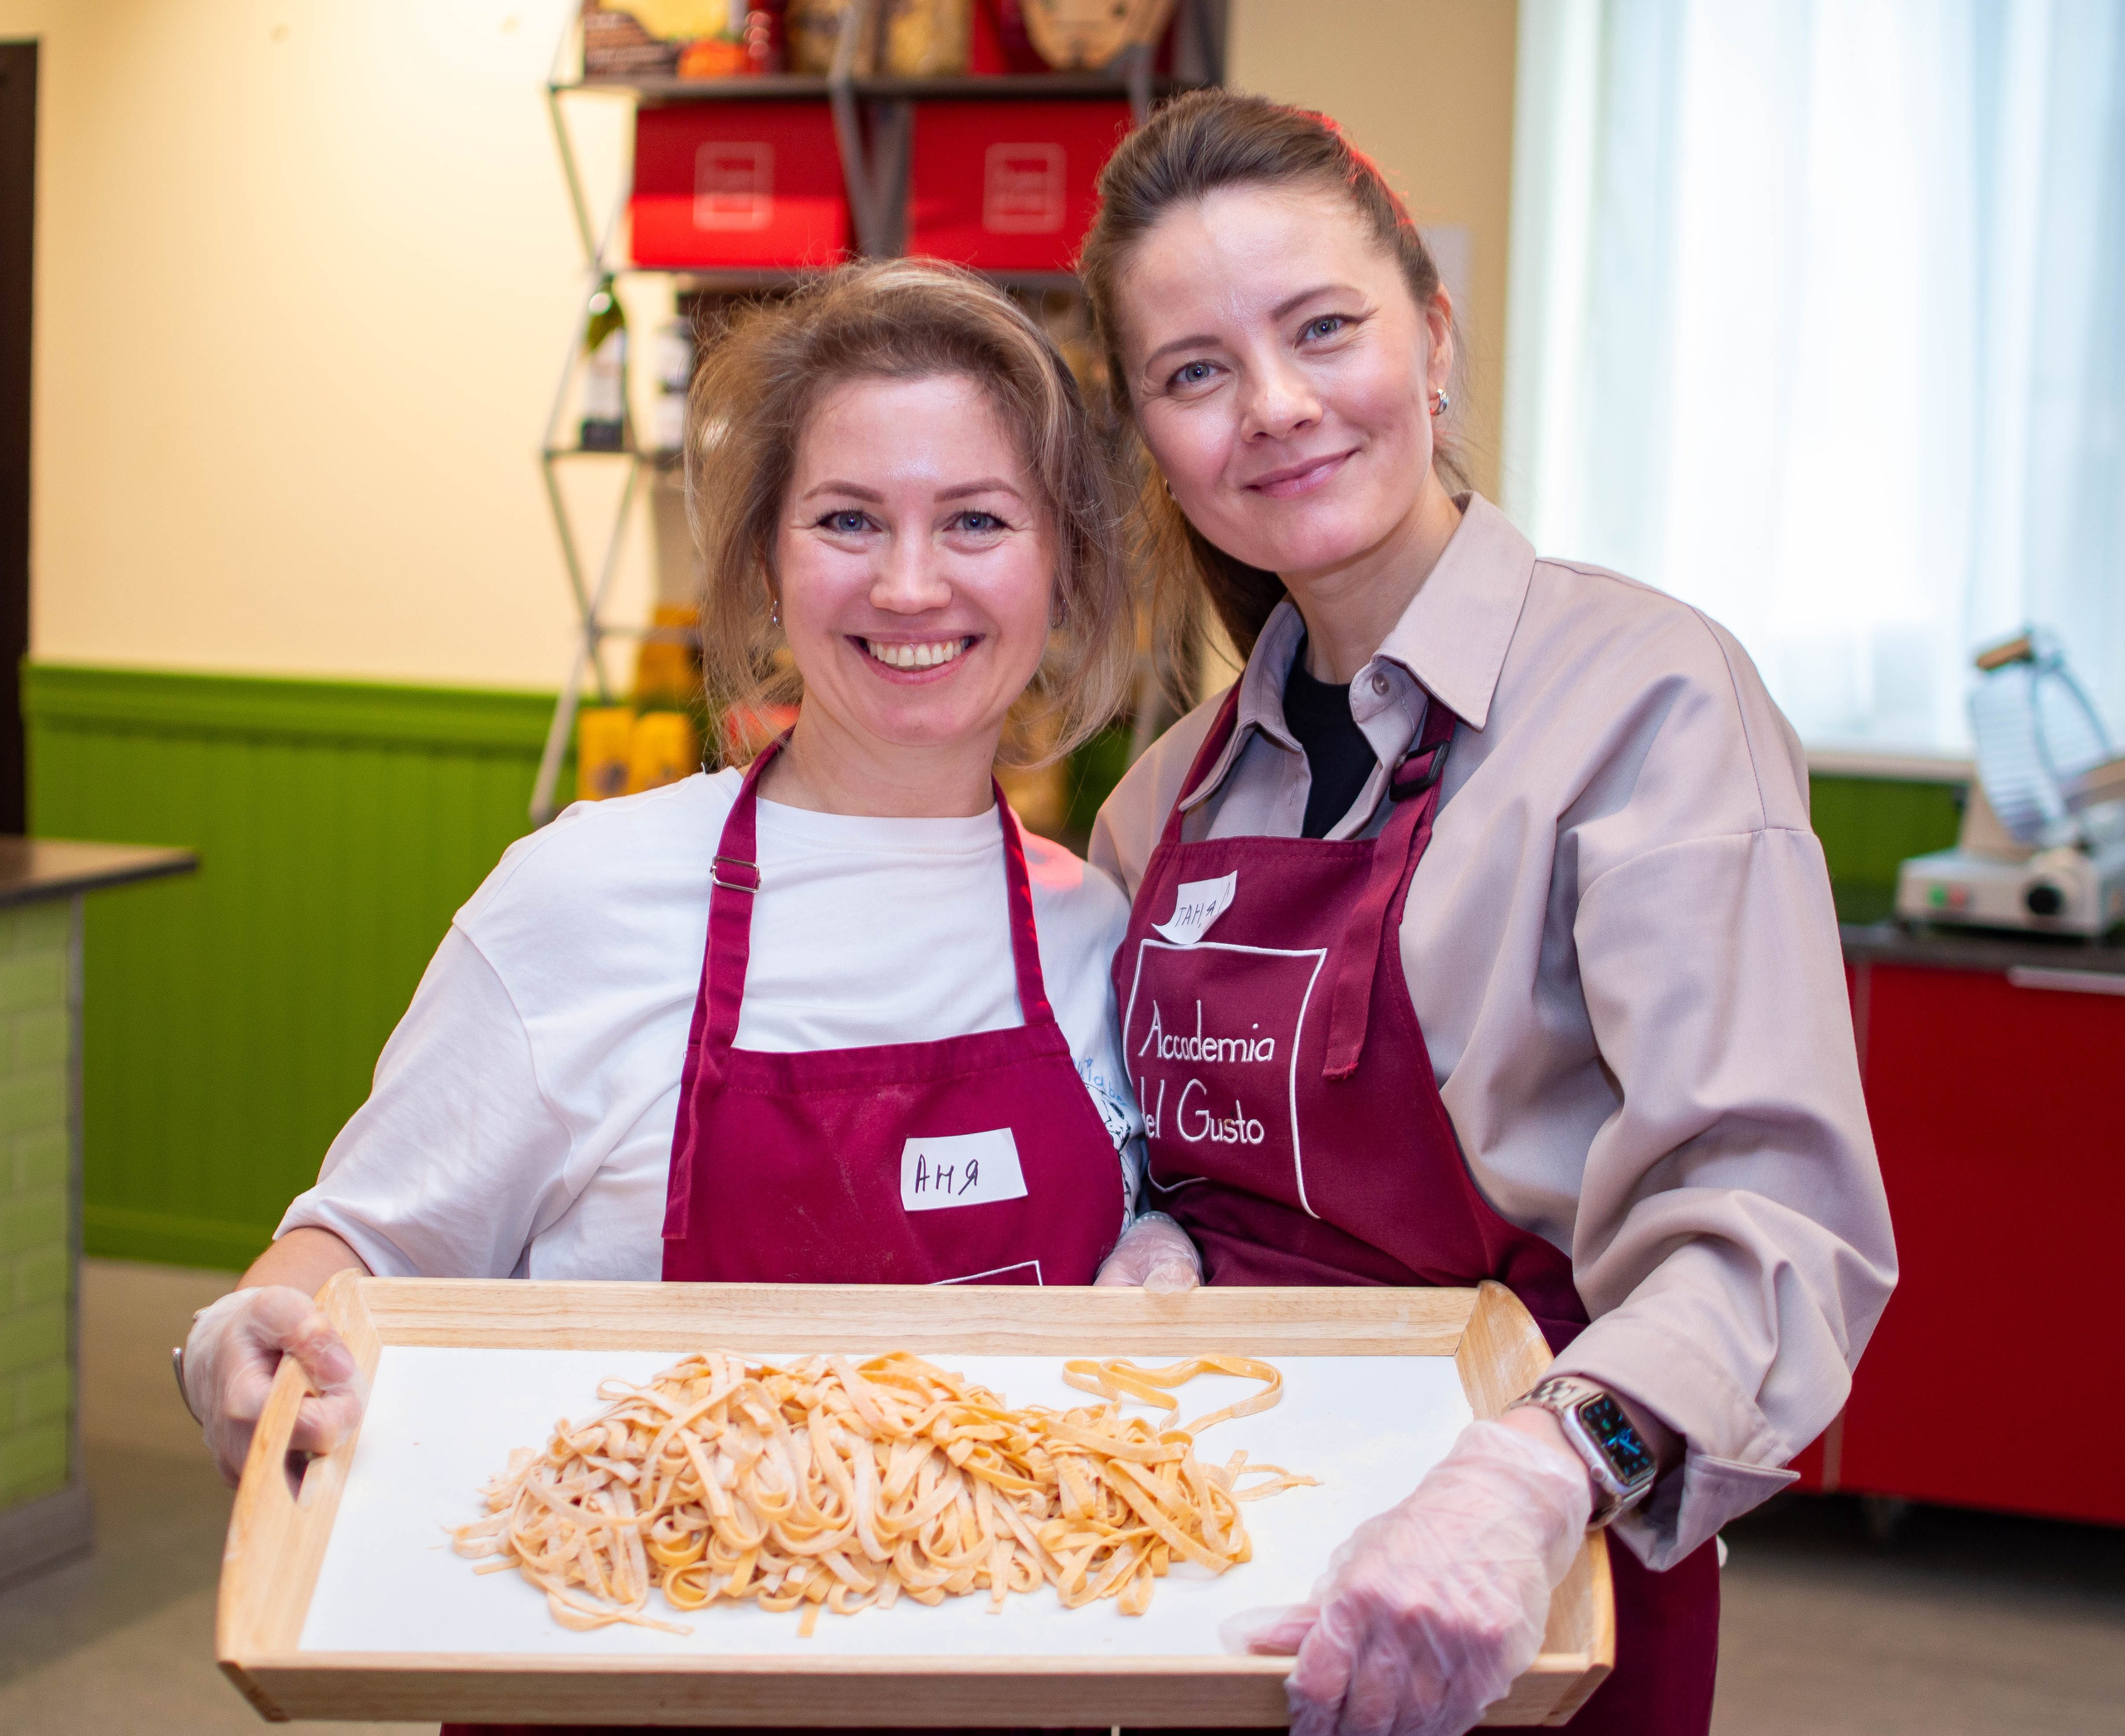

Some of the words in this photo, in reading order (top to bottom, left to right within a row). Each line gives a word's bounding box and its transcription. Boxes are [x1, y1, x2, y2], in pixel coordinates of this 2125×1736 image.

[1137, 999, 1276, 1064] Accademia
[1176, 1078, 1265, 1145] Gusto
[915, 1153, 979, 1196] АНЯ
